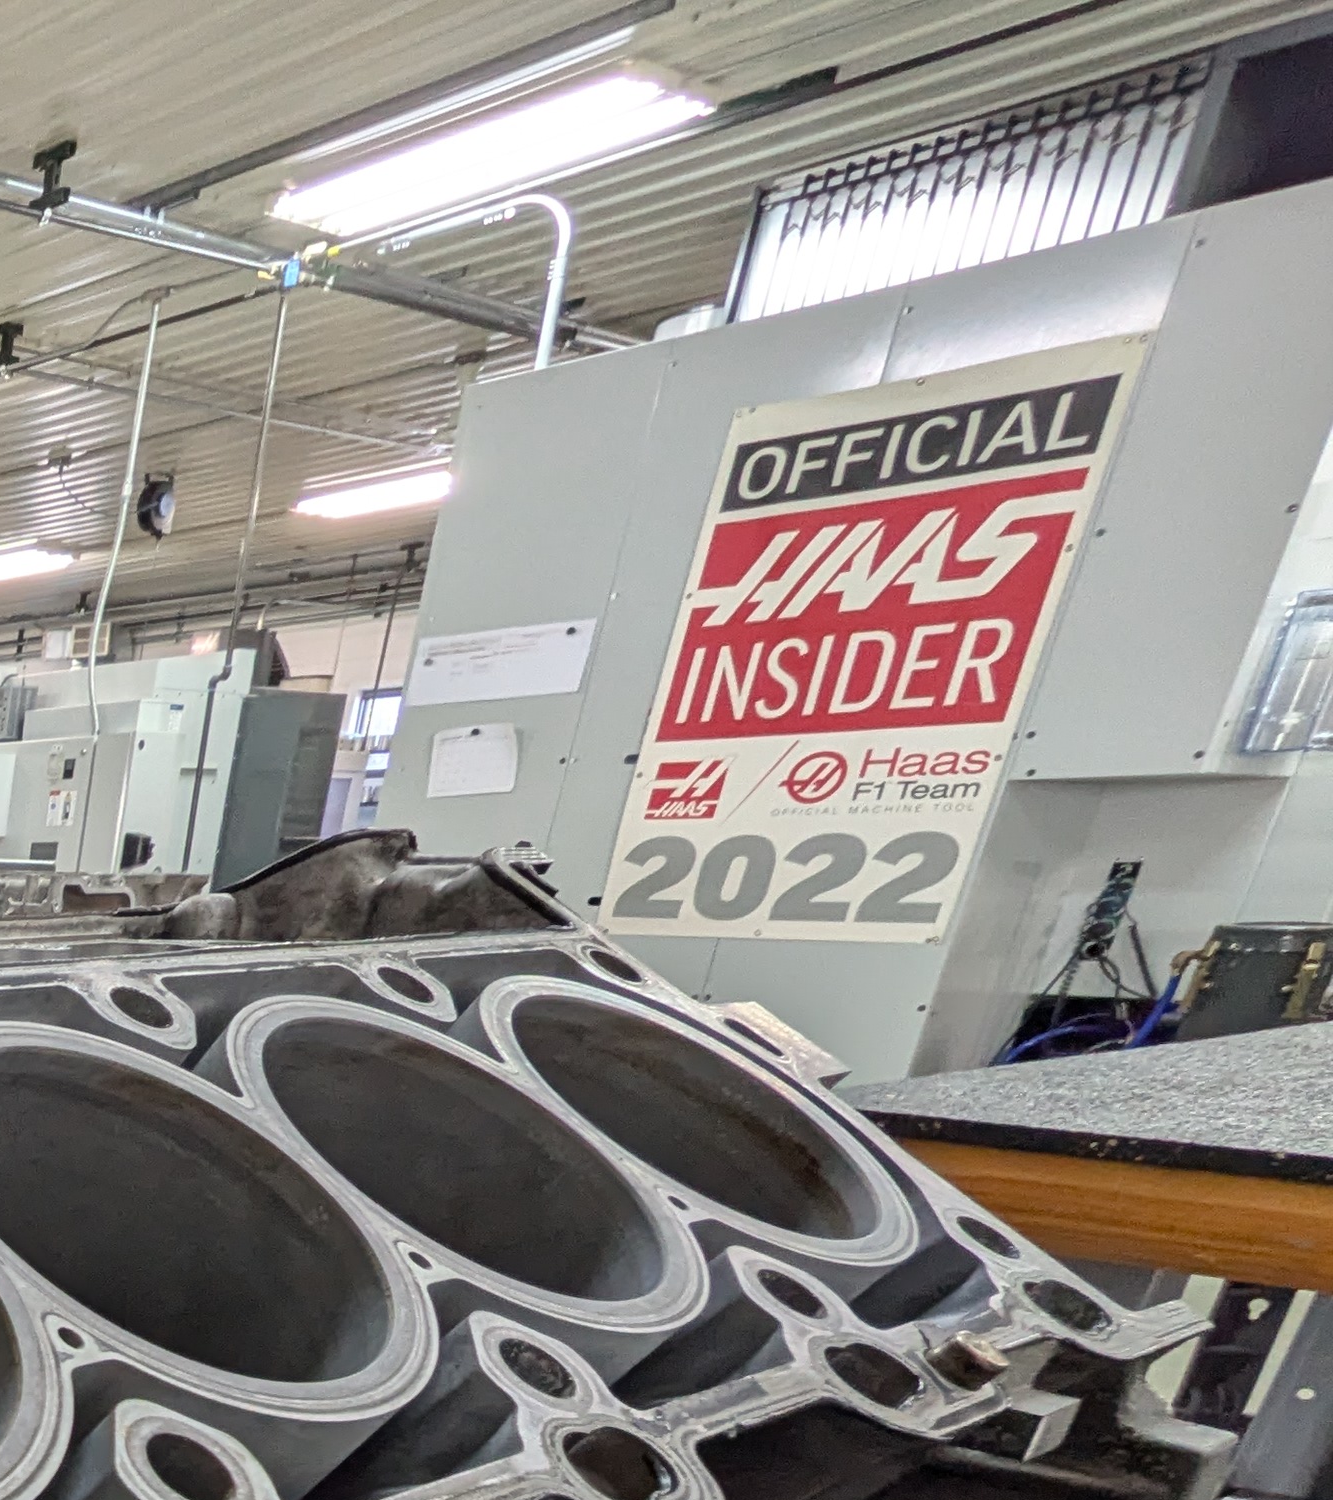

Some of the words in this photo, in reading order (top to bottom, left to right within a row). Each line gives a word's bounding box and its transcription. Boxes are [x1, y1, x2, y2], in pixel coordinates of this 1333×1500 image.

[737, 391, 1090, 500] OFFICIAL
[691, 490, 1081, 628] HAAS
[674, 617, 1013, 724] INSIDER
[852, 781, 885, 801] F1
[897, 780, 981, 800] Team
[859, 747, 991, 779] Haas
[646, 800, 719, 818] HAAS
[770, 806, 838, 817] OFFICIAL
[848, 804, 922, 814] MACHINE
[933, 802, 975, 812] TOOL
[612, 831, 960, 923] 2022
